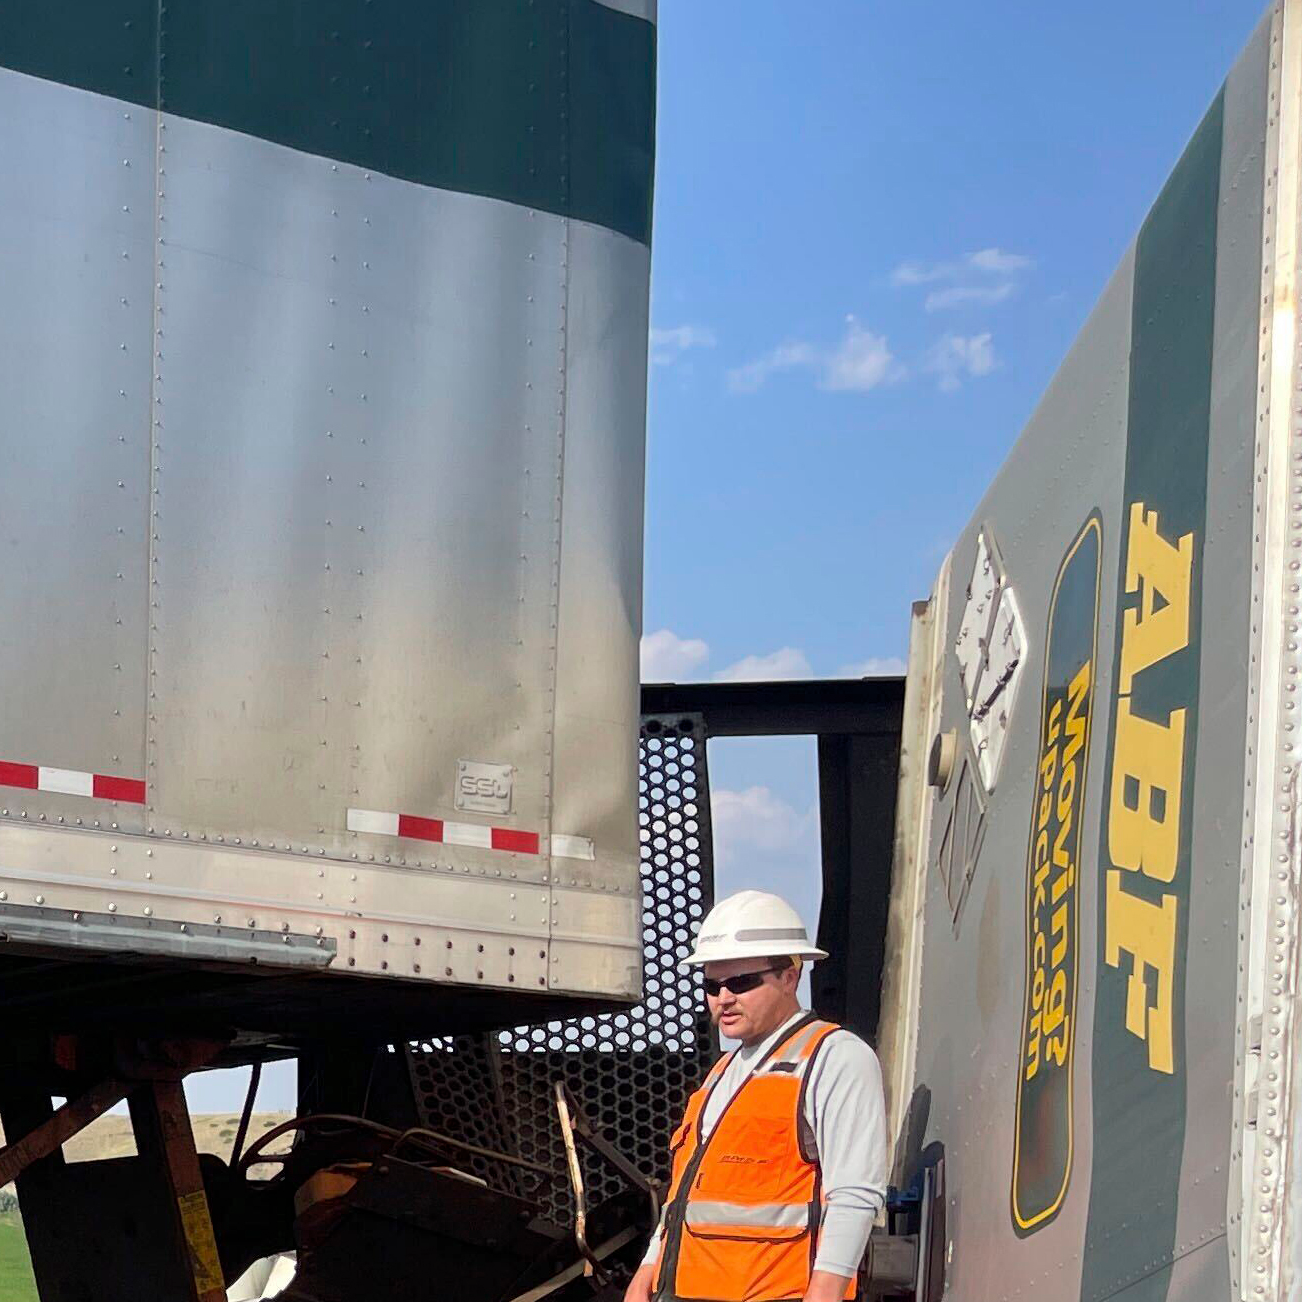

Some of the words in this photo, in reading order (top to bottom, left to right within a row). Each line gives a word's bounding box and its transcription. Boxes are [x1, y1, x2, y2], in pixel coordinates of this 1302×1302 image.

[1026, 697, 1063, 1081] upack.com
[1045, 659, 1091, 1068] Moving?
[1105, 500, 1195, 1075] ABF
